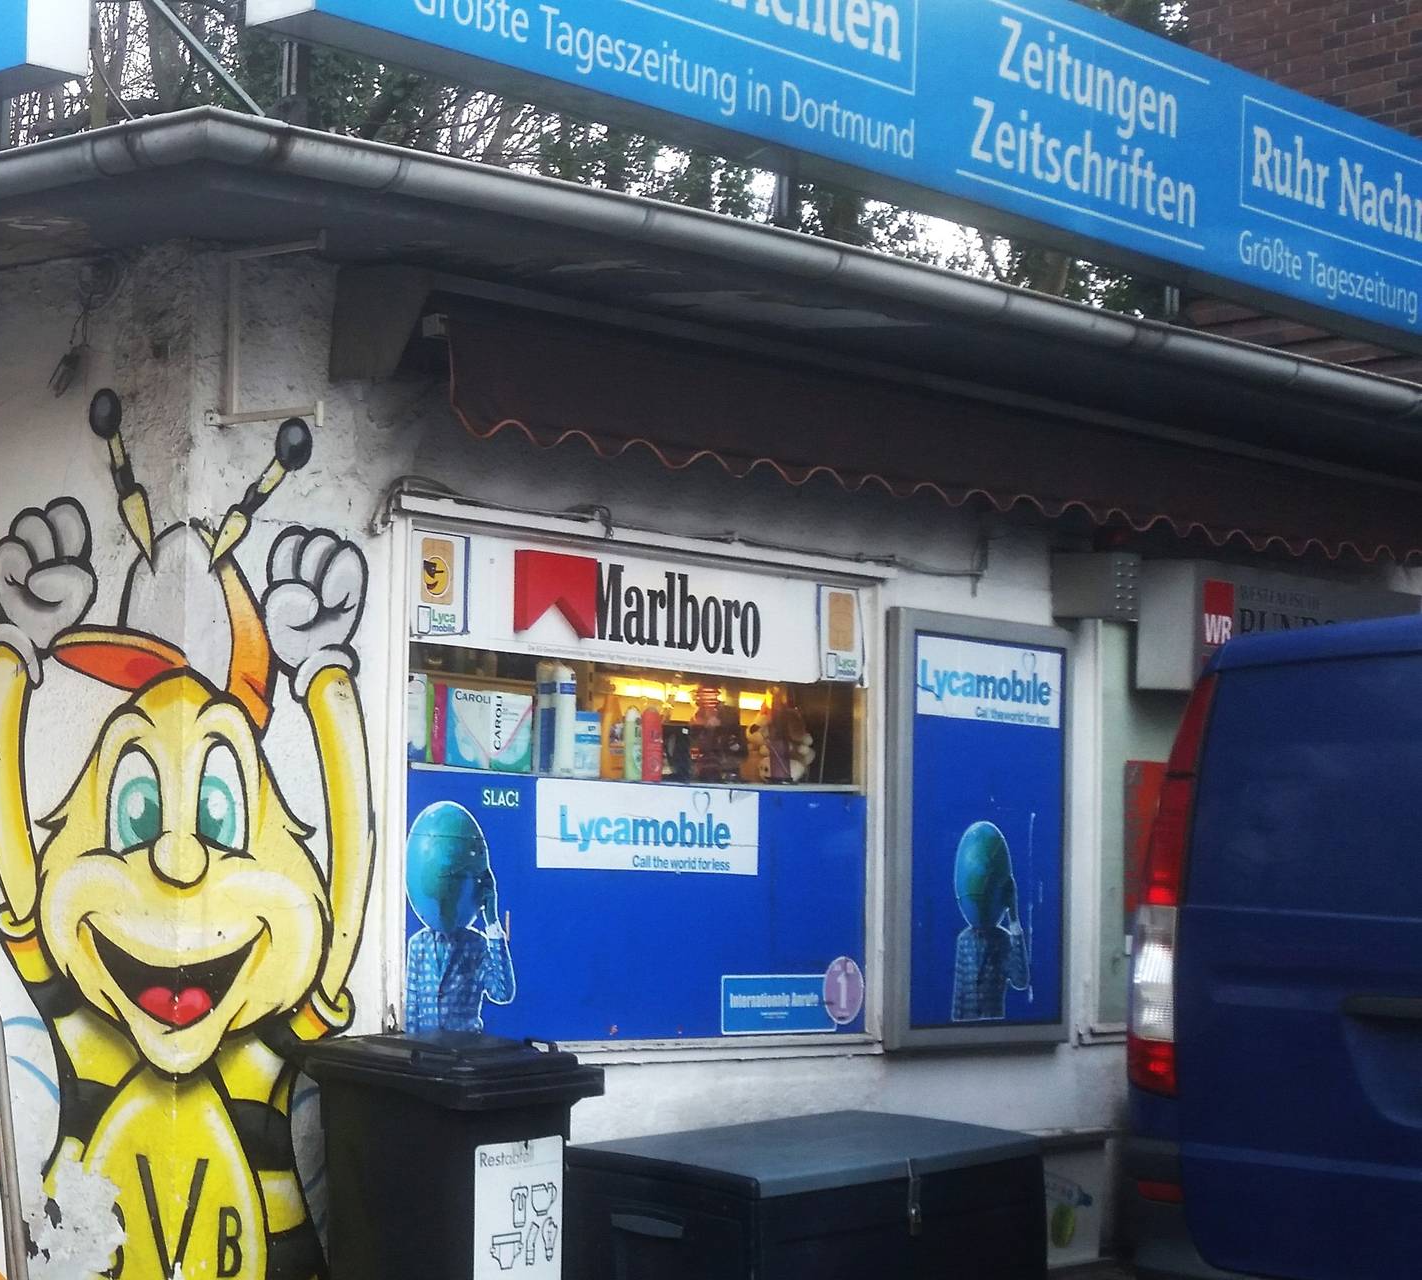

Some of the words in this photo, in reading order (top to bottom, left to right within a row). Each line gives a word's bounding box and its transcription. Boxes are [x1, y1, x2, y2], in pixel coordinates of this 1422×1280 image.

[539, 4, 737, 116] Tageszeitung
[746, 68, 771, 116] in
[781, 80, 915, 159] Dortmund
[999, 16, 1178, 140] Zeitungen
[970, 95, 1196, 228] Zeitschriften
[1252, 125, 1329, 209] Ruhr
[1239, 230, 1303, 281] Größte
[1307, 250, 1418, 324] Tageszeitung
[432, 609, 456, 625] Lyca
[432, 624, 456, 633] mobile
[592, 563, 762, 659] Marlboro
[1204, 612, 1233, 645] WR
[456, 690, 492, 704] CAROLI
[922, 659, 1051, 706] Lycamobile
[494, 695, 503, 751] CAROLI
[560, 805, 731, 852] Lycamobile
[633, 855, 651, 868] Call
[653, 856, 668, 869] the
[670, 857, 697, 870] world
[698, 858, 711, 870] for
[712, 859, 730, 871] less
